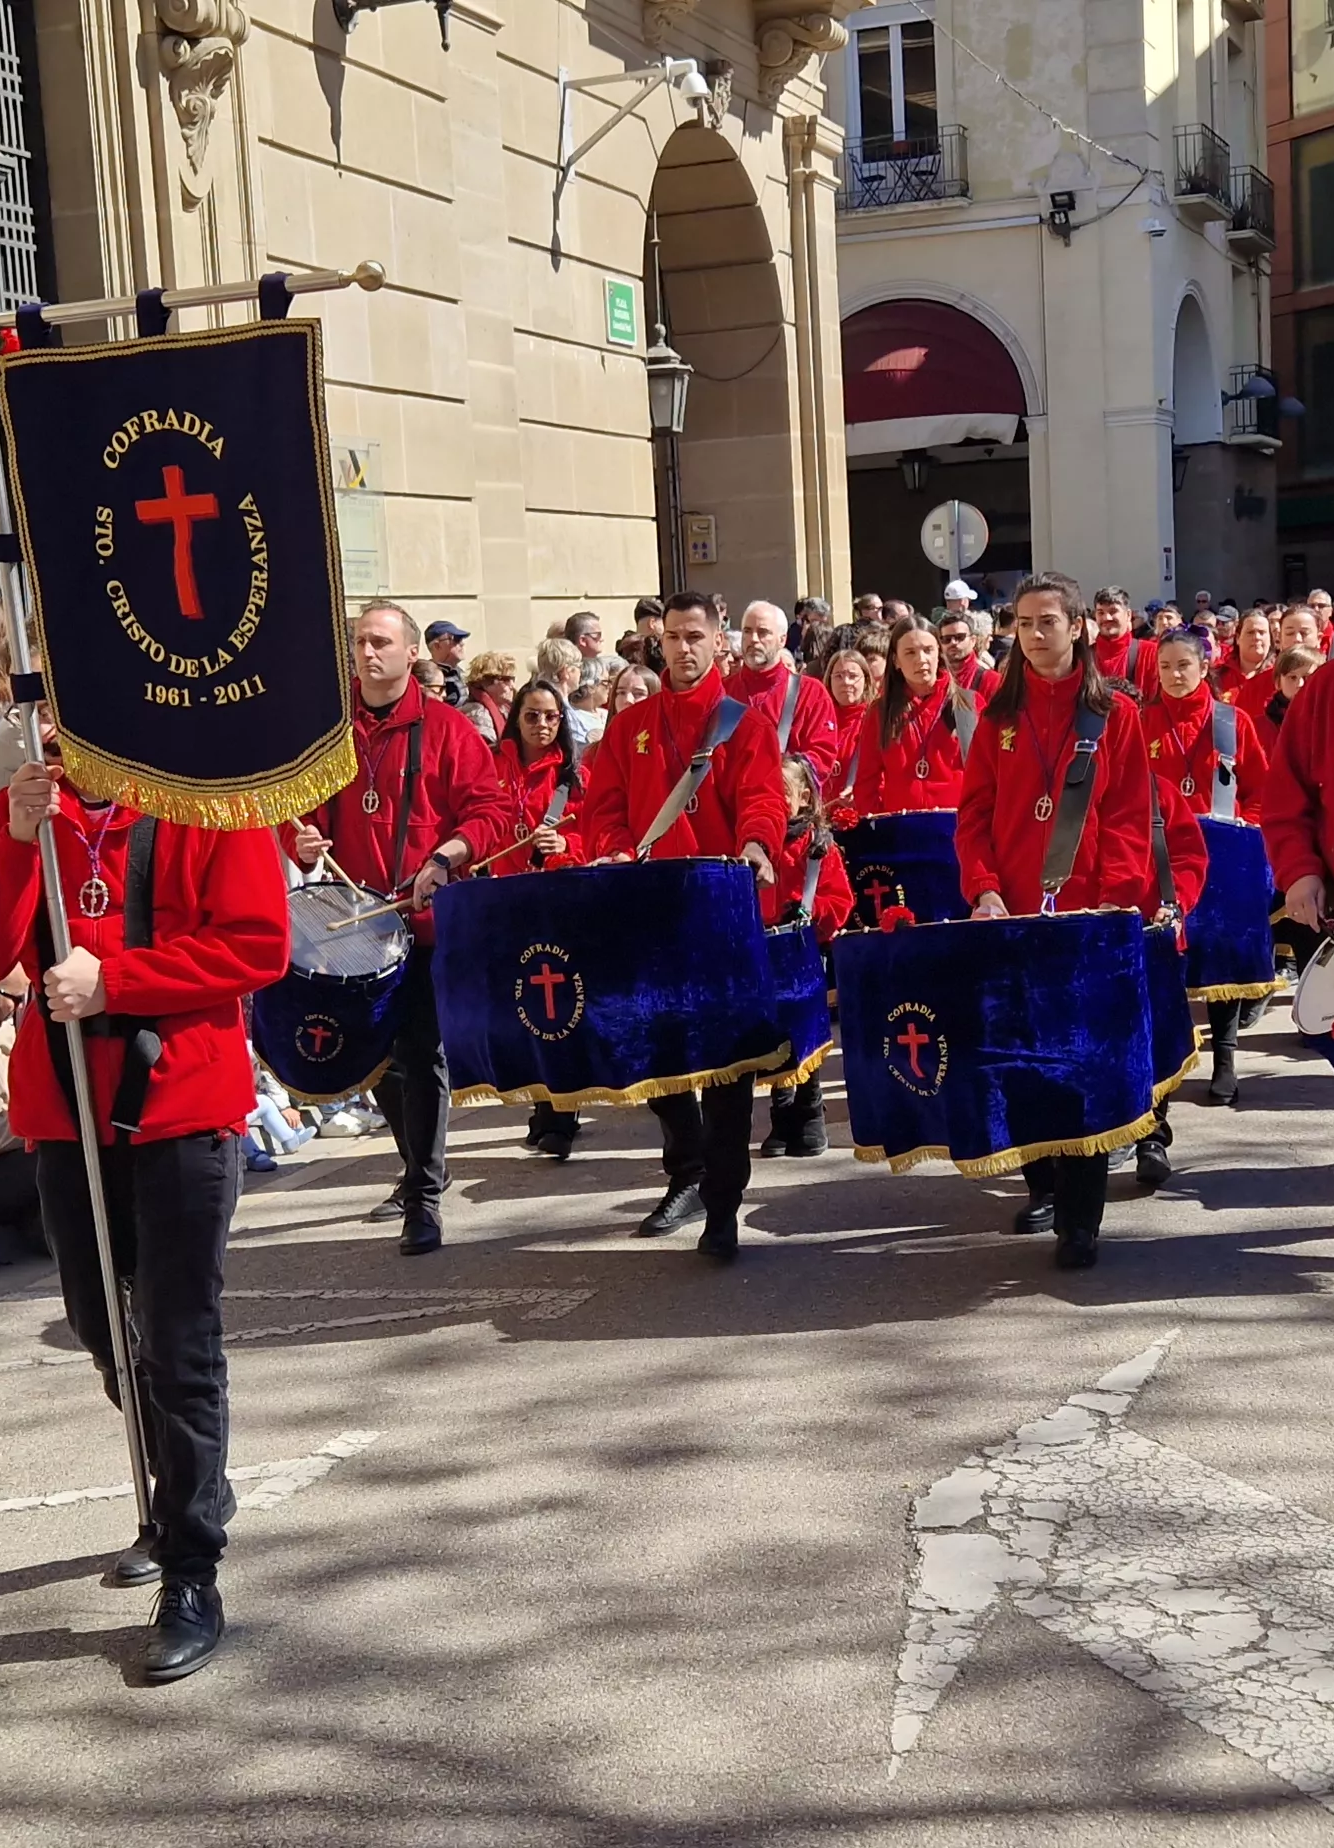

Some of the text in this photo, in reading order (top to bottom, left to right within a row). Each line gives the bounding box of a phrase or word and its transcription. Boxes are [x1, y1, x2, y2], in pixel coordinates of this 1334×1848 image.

[103, 408, 226, 469] COFRADIA
[95, 492, 269, 679] STO. CRISTO DE LA ESPERANZA
[143, 682, 193, 707] 1961
[213, 674, 267, 706] 2011
[519, 943, 570, 964] COFRADIA
[517, 1005, 540, 1036] CRISTO
[542, 1032, 556, 1041] DE
[556, 1028, 571, 1040] LA
[567, 972, 585, 1029] ESPERANZA
[887, 1002, 937, 1023] COFRADIA
